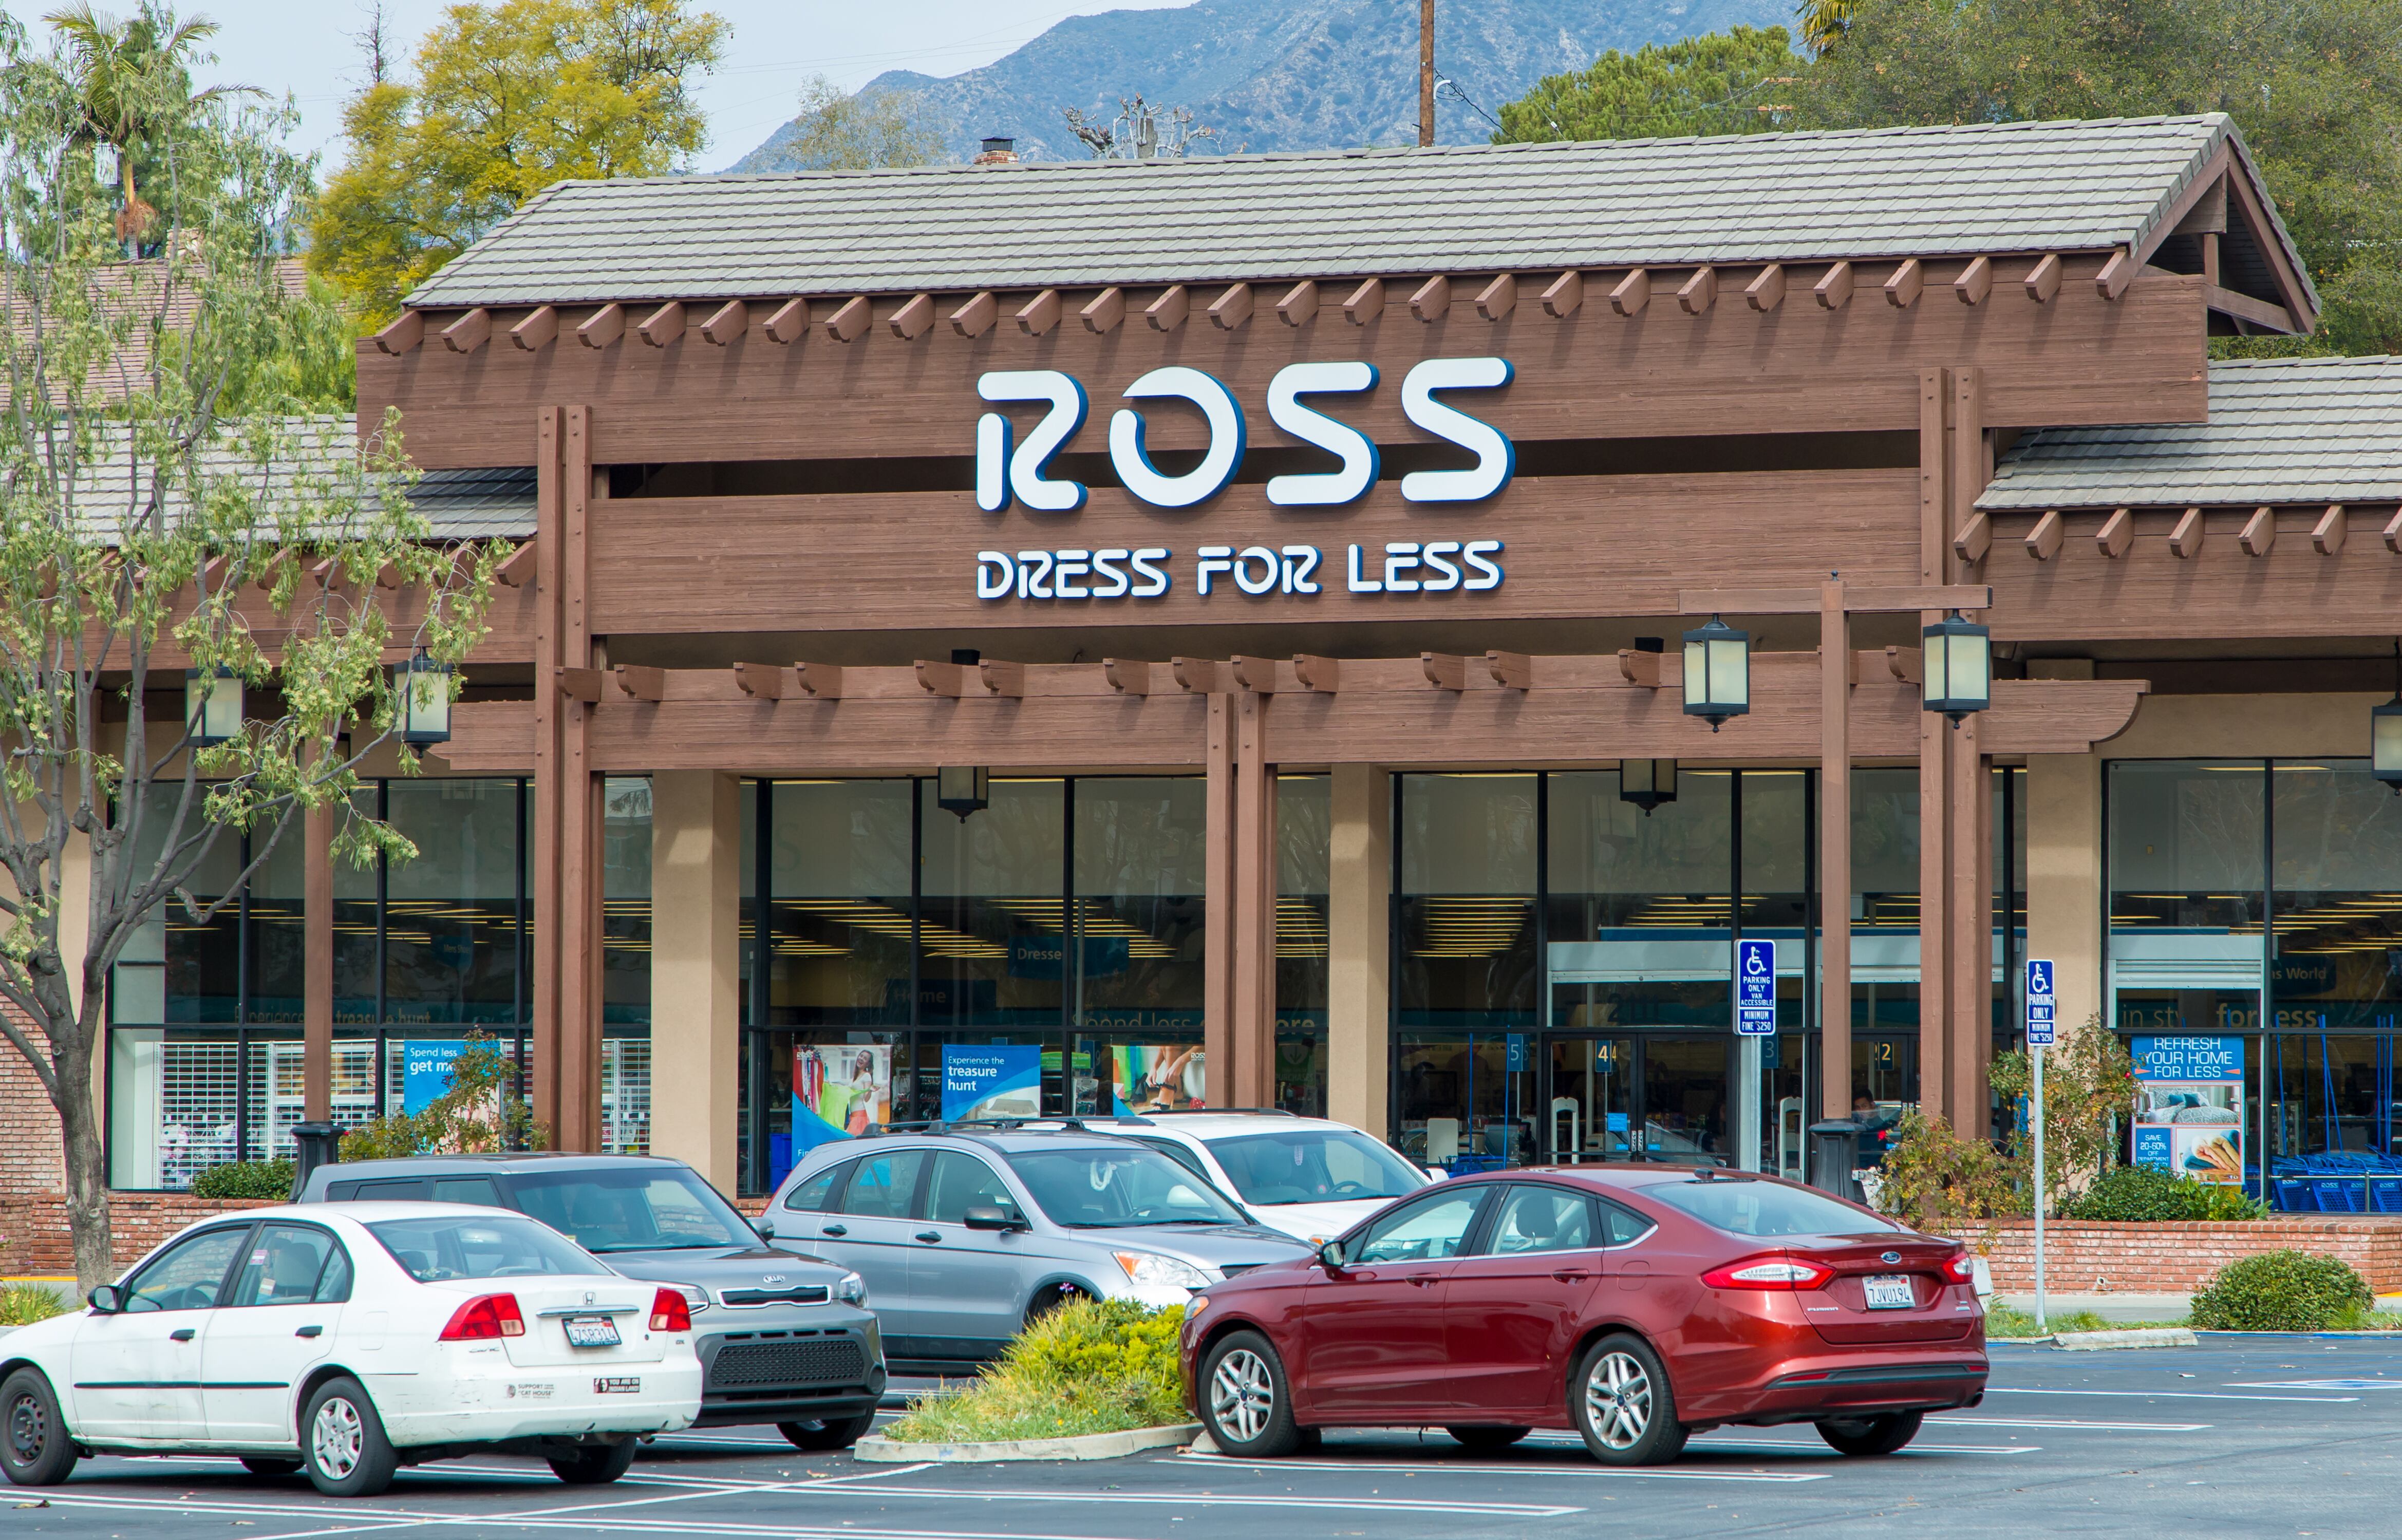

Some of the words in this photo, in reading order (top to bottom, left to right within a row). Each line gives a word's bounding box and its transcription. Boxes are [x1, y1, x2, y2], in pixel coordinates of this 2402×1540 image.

[976, 357, 1515, 512] ROSS
[977, 548, 1173, 600] DRESS
[1197, 545, 1323, 596] FOR
[1348, 540, 1505, 593] LESS
[1018, 948, 1062, 960] Dresse
[2285, 967, 2326, 979] World
[894, 987, 946, 1003] Hme
[2029, 993, 2053, 1006] PARKING
[1744, 1011, 1769, 1020] MINIMUM
[2033, 1007, 2049, 1019] ONLY
[2123, 1004, 2143, 1027] in
[2216, 1003, 2257, 1027] for
[2276, 1010, 2317, 1028] ess
[1742, 1022, 1754, 1030] FINE
[1757, 1021, 1771, 1031] $250
[2032, 1023, 2051, 1031] MINIMUM
[2030, 1033, 2039, 1042] FINE
[2041, 1033, 2052, 1042] $250
[2154, 1037, 2221, 1050] REFRESH
[410, 1048, 438, 1059] Spend
[441, 1048, 457, 1057] less
[1511, 1044, 1519, 1061] 5
[1598, 1045, 1608, 1062] 4
[1612, 1045, 1617, 1062] 4
[1766, 1041, 1774, 1058] 3
[1882, 1043, 1891, 1060] 2
[948, 1056, 989, 1065] Experience
[2145, 1051, 2183, 1064] YOUR
[2188, 1051, 2232, 1064] HOME
[410, 1060, 433, 1075] get
[948, 1066, 997, 1077] treasure
[2155, 1066, 2181, 1078] FOR
[2187, 1066, 2221, 1078] LESS
[948, 1079, 977, 1091] hunt
[2140, 1142, 2166, 1150] 20-60%
[1869, 1288, 1910, 1303] 7JVU194
[570, 1328, 615, 1342] 4ZSR314
